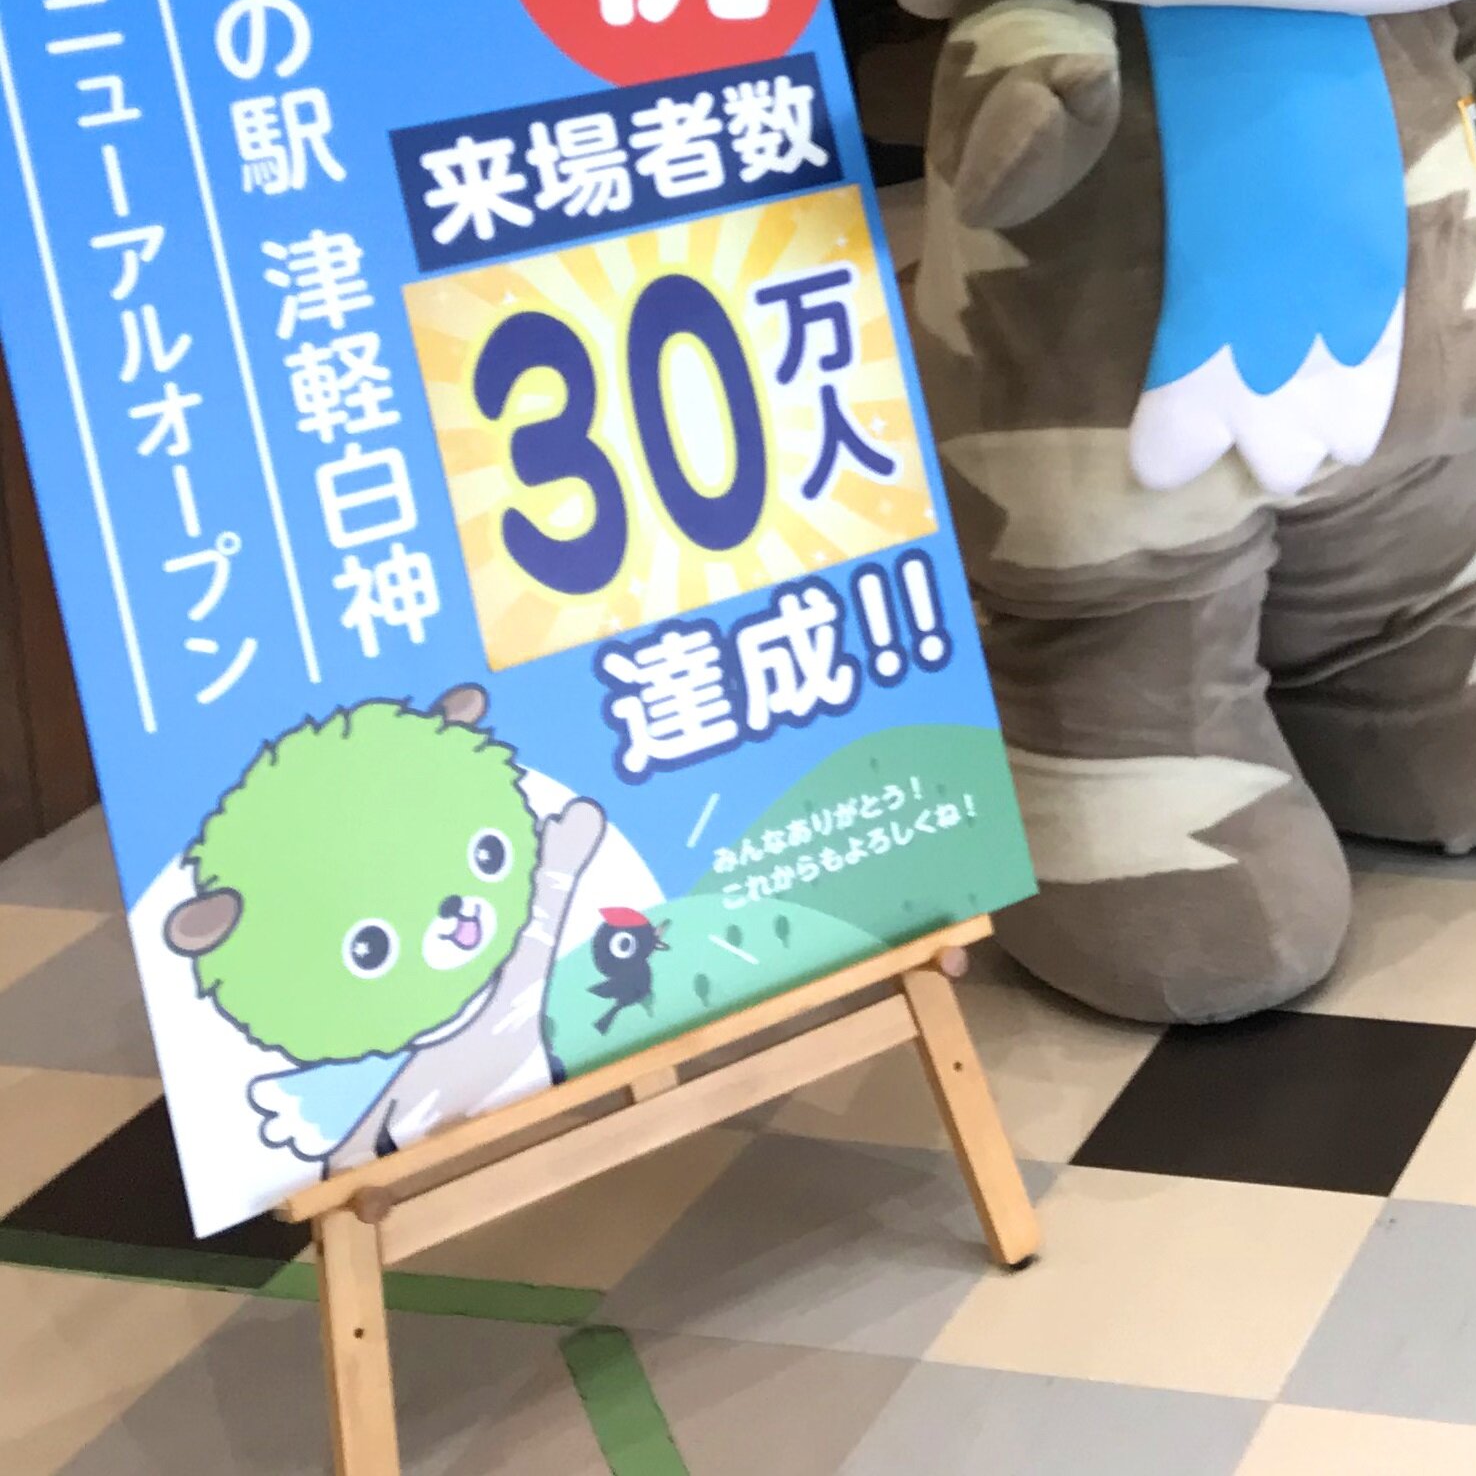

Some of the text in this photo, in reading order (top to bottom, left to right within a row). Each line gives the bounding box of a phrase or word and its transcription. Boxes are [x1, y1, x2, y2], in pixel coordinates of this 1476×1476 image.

[418, 73, 829, 248] 来場者数
[261, 228, 440, 658] 津軽白神
